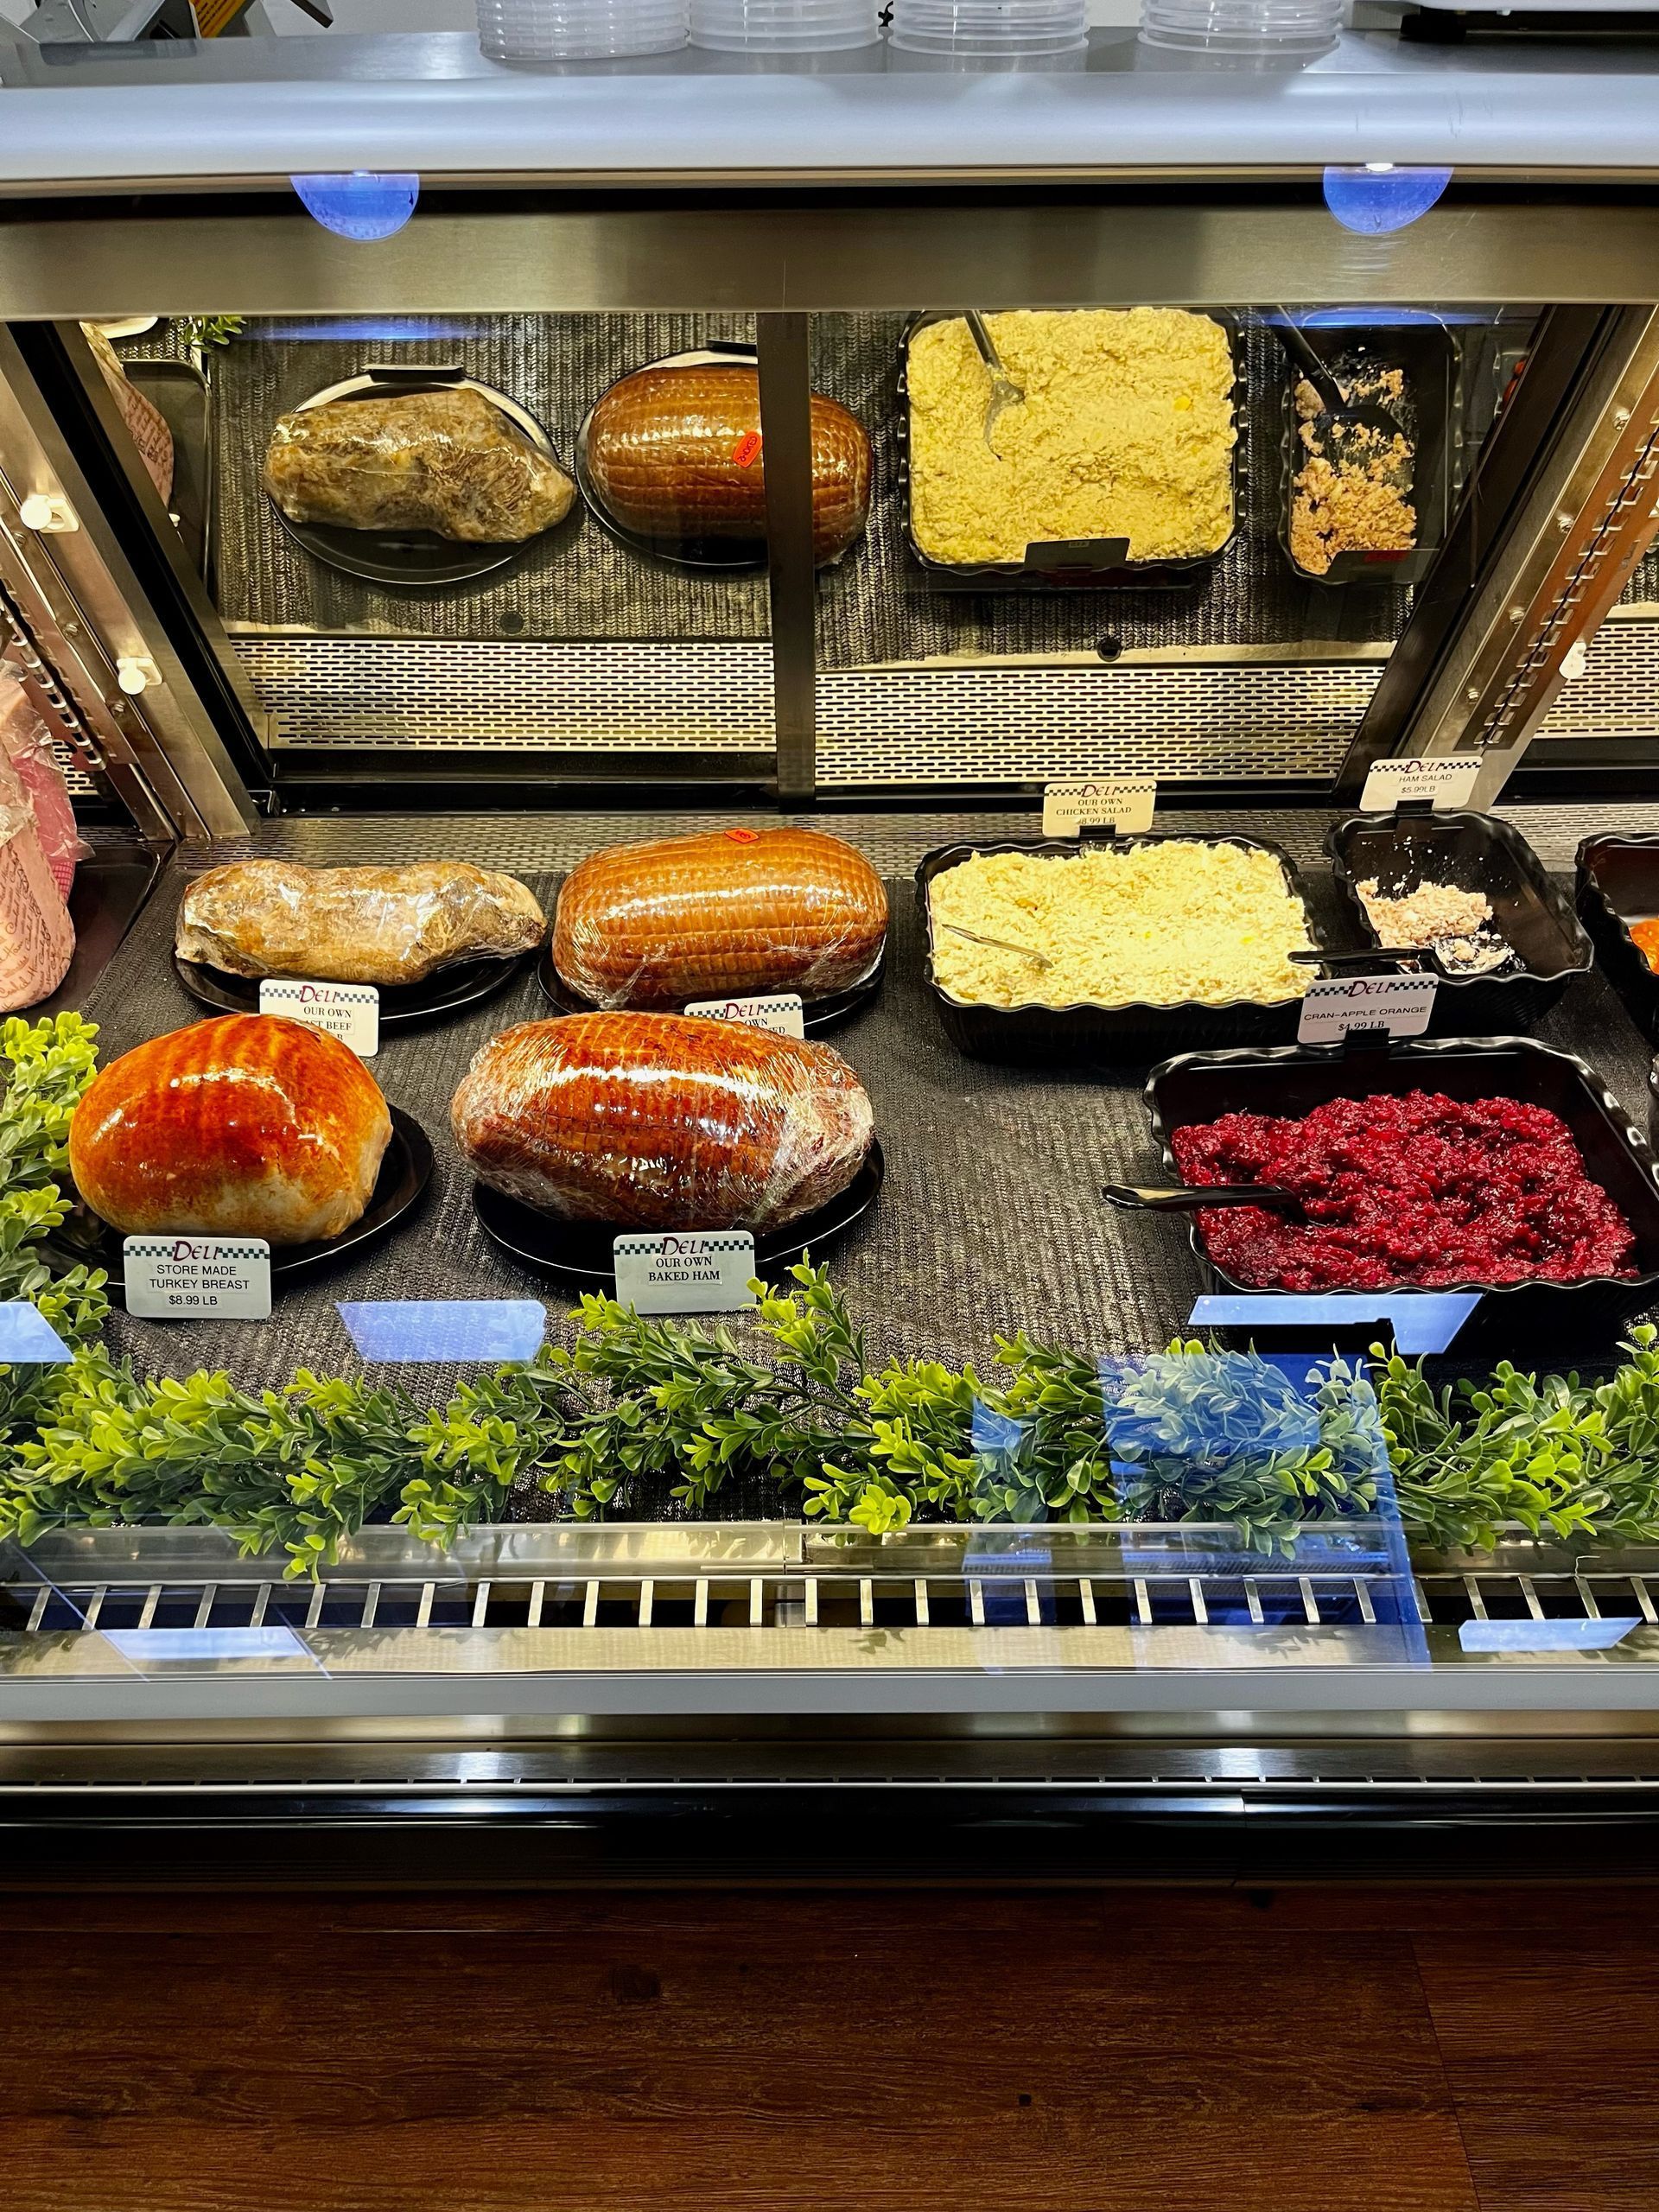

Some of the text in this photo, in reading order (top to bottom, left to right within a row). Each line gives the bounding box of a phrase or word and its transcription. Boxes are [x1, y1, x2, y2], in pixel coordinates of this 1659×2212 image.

[303, 1007, 352, 1018] OUR OWN
[1304, 1009, 1376, 1020] CRAN-APPLE
[326, 1021, 353, 1031] BEEF
[744, 1018, 768, 1027] OWN
[1370, 1020, 1384, 1029] LB
[656, 1256, 712, 1268] OUR OWN
[156, 1264, 237, 1275] STORE MADE
[649, 1270, 720, 1281] BAKED HAM
[149, 1279, 250, 1290] TURKEY BREAST
[168, 1295, 218, 1306] $8.99 LB
